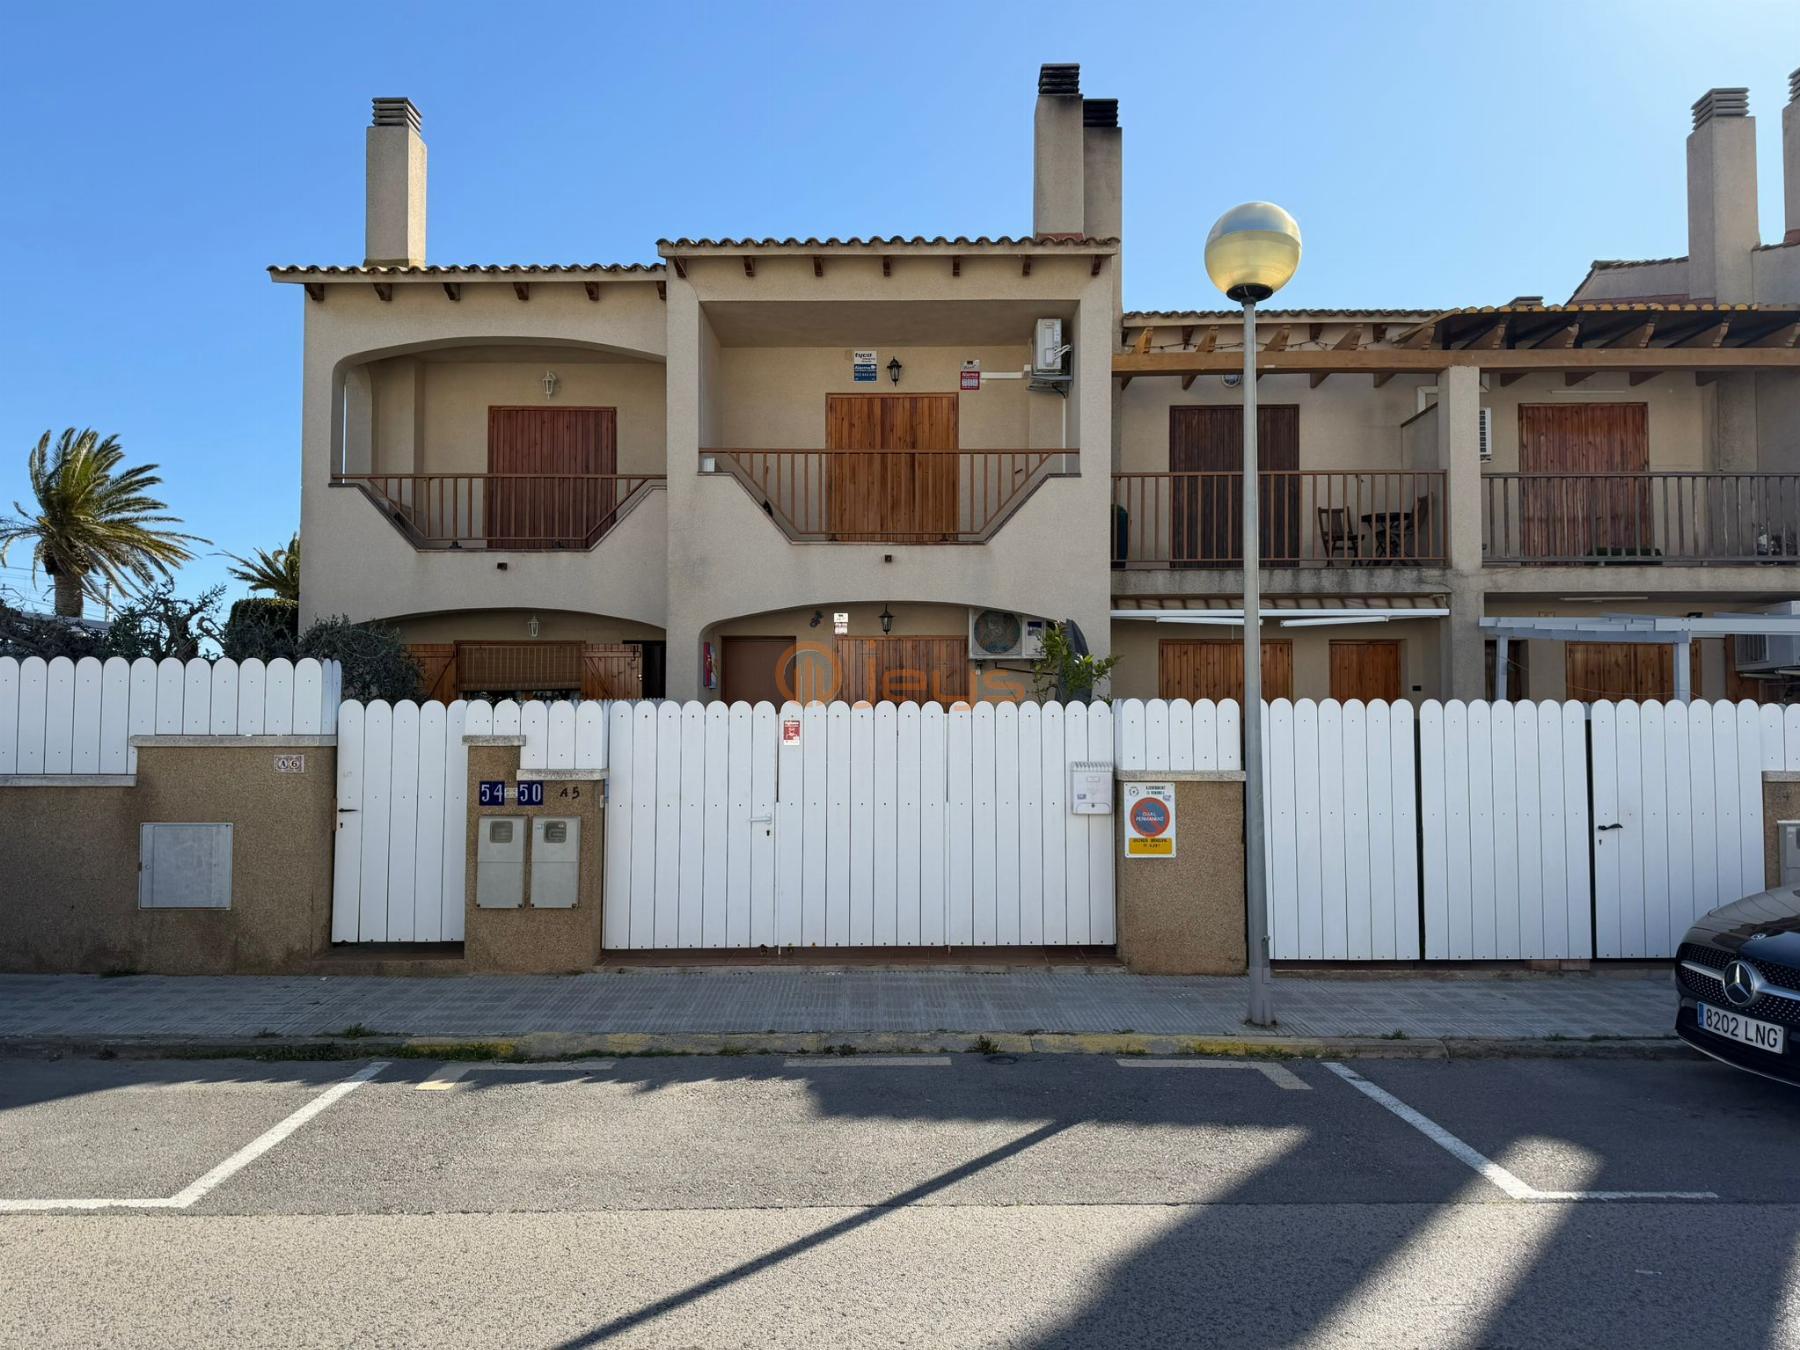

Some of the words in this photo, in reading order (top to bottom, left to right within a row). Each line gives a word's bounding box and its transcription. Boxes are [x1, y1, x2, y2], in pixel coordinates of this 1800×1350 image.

[481, 784, 503, 802] 54
[519, 784, 542, 802] 50
[1706, 1008, 1739, 1037] 8202
[1744, 1021, 1778, 1048] LNG
